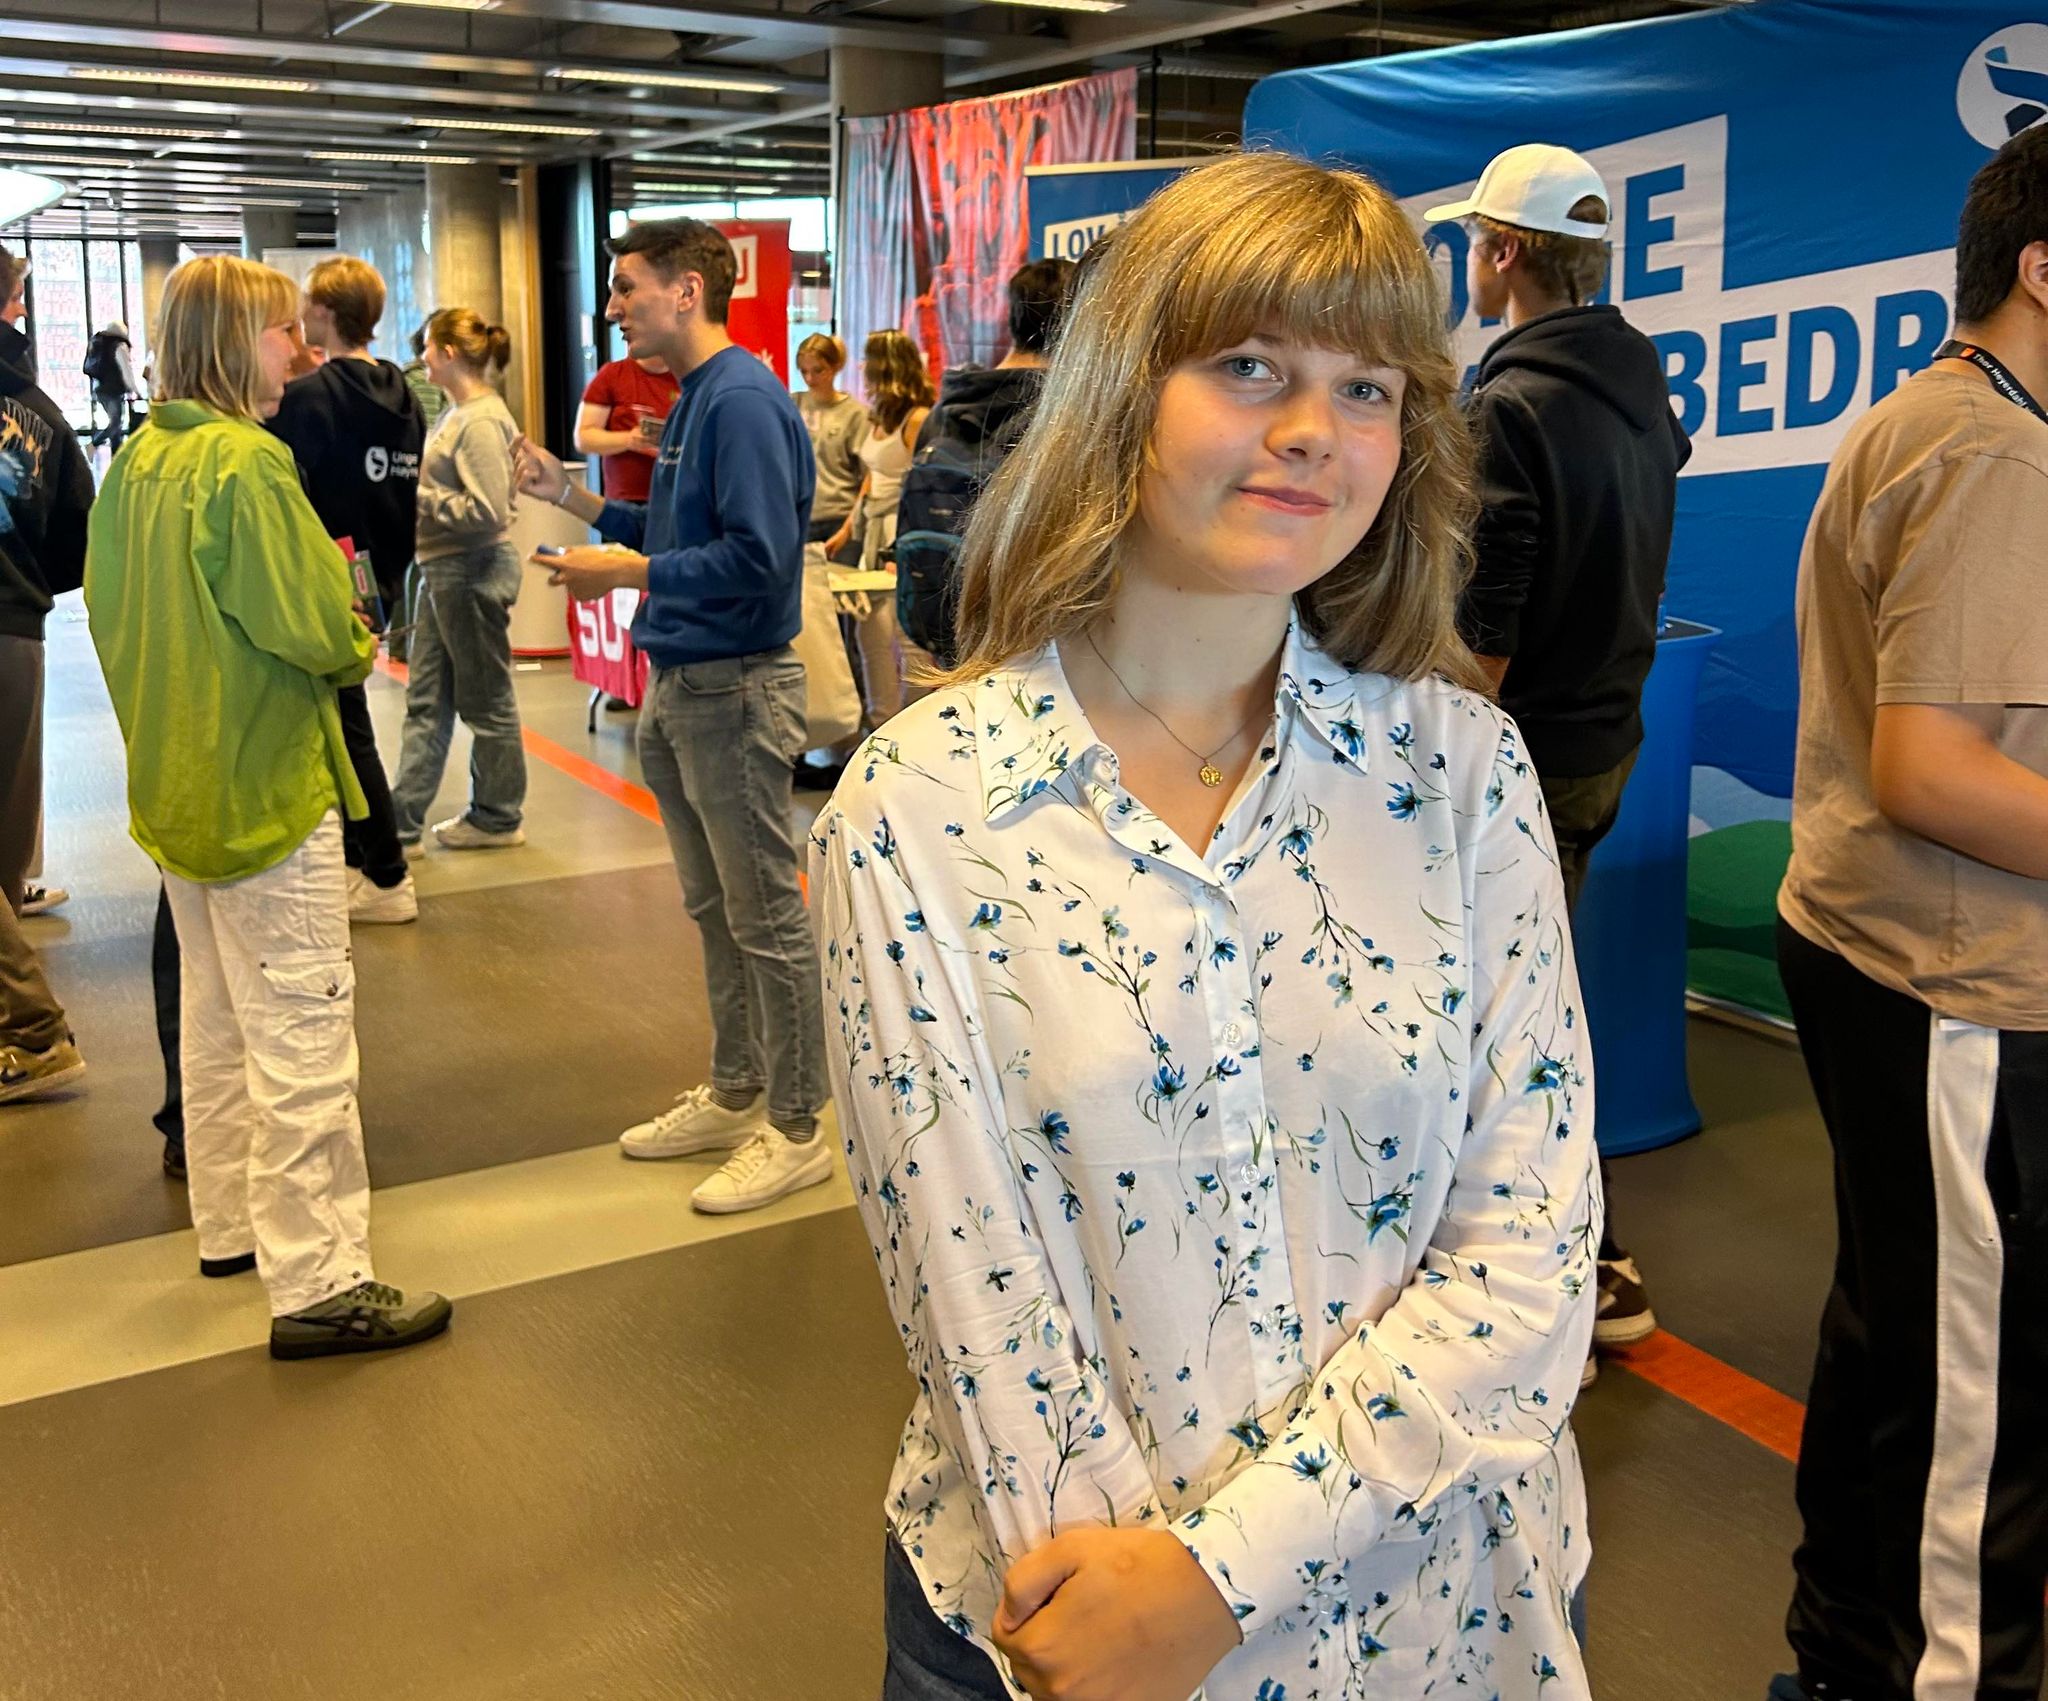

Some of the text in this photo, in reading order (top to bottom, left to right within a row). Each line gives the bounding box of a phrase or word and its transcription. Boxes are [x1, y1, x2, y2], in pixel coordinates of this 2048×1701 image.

[1650, 289, 1949, 438] BEDR
[1973, 352, 2028, 407] Thor Heyerdahl
